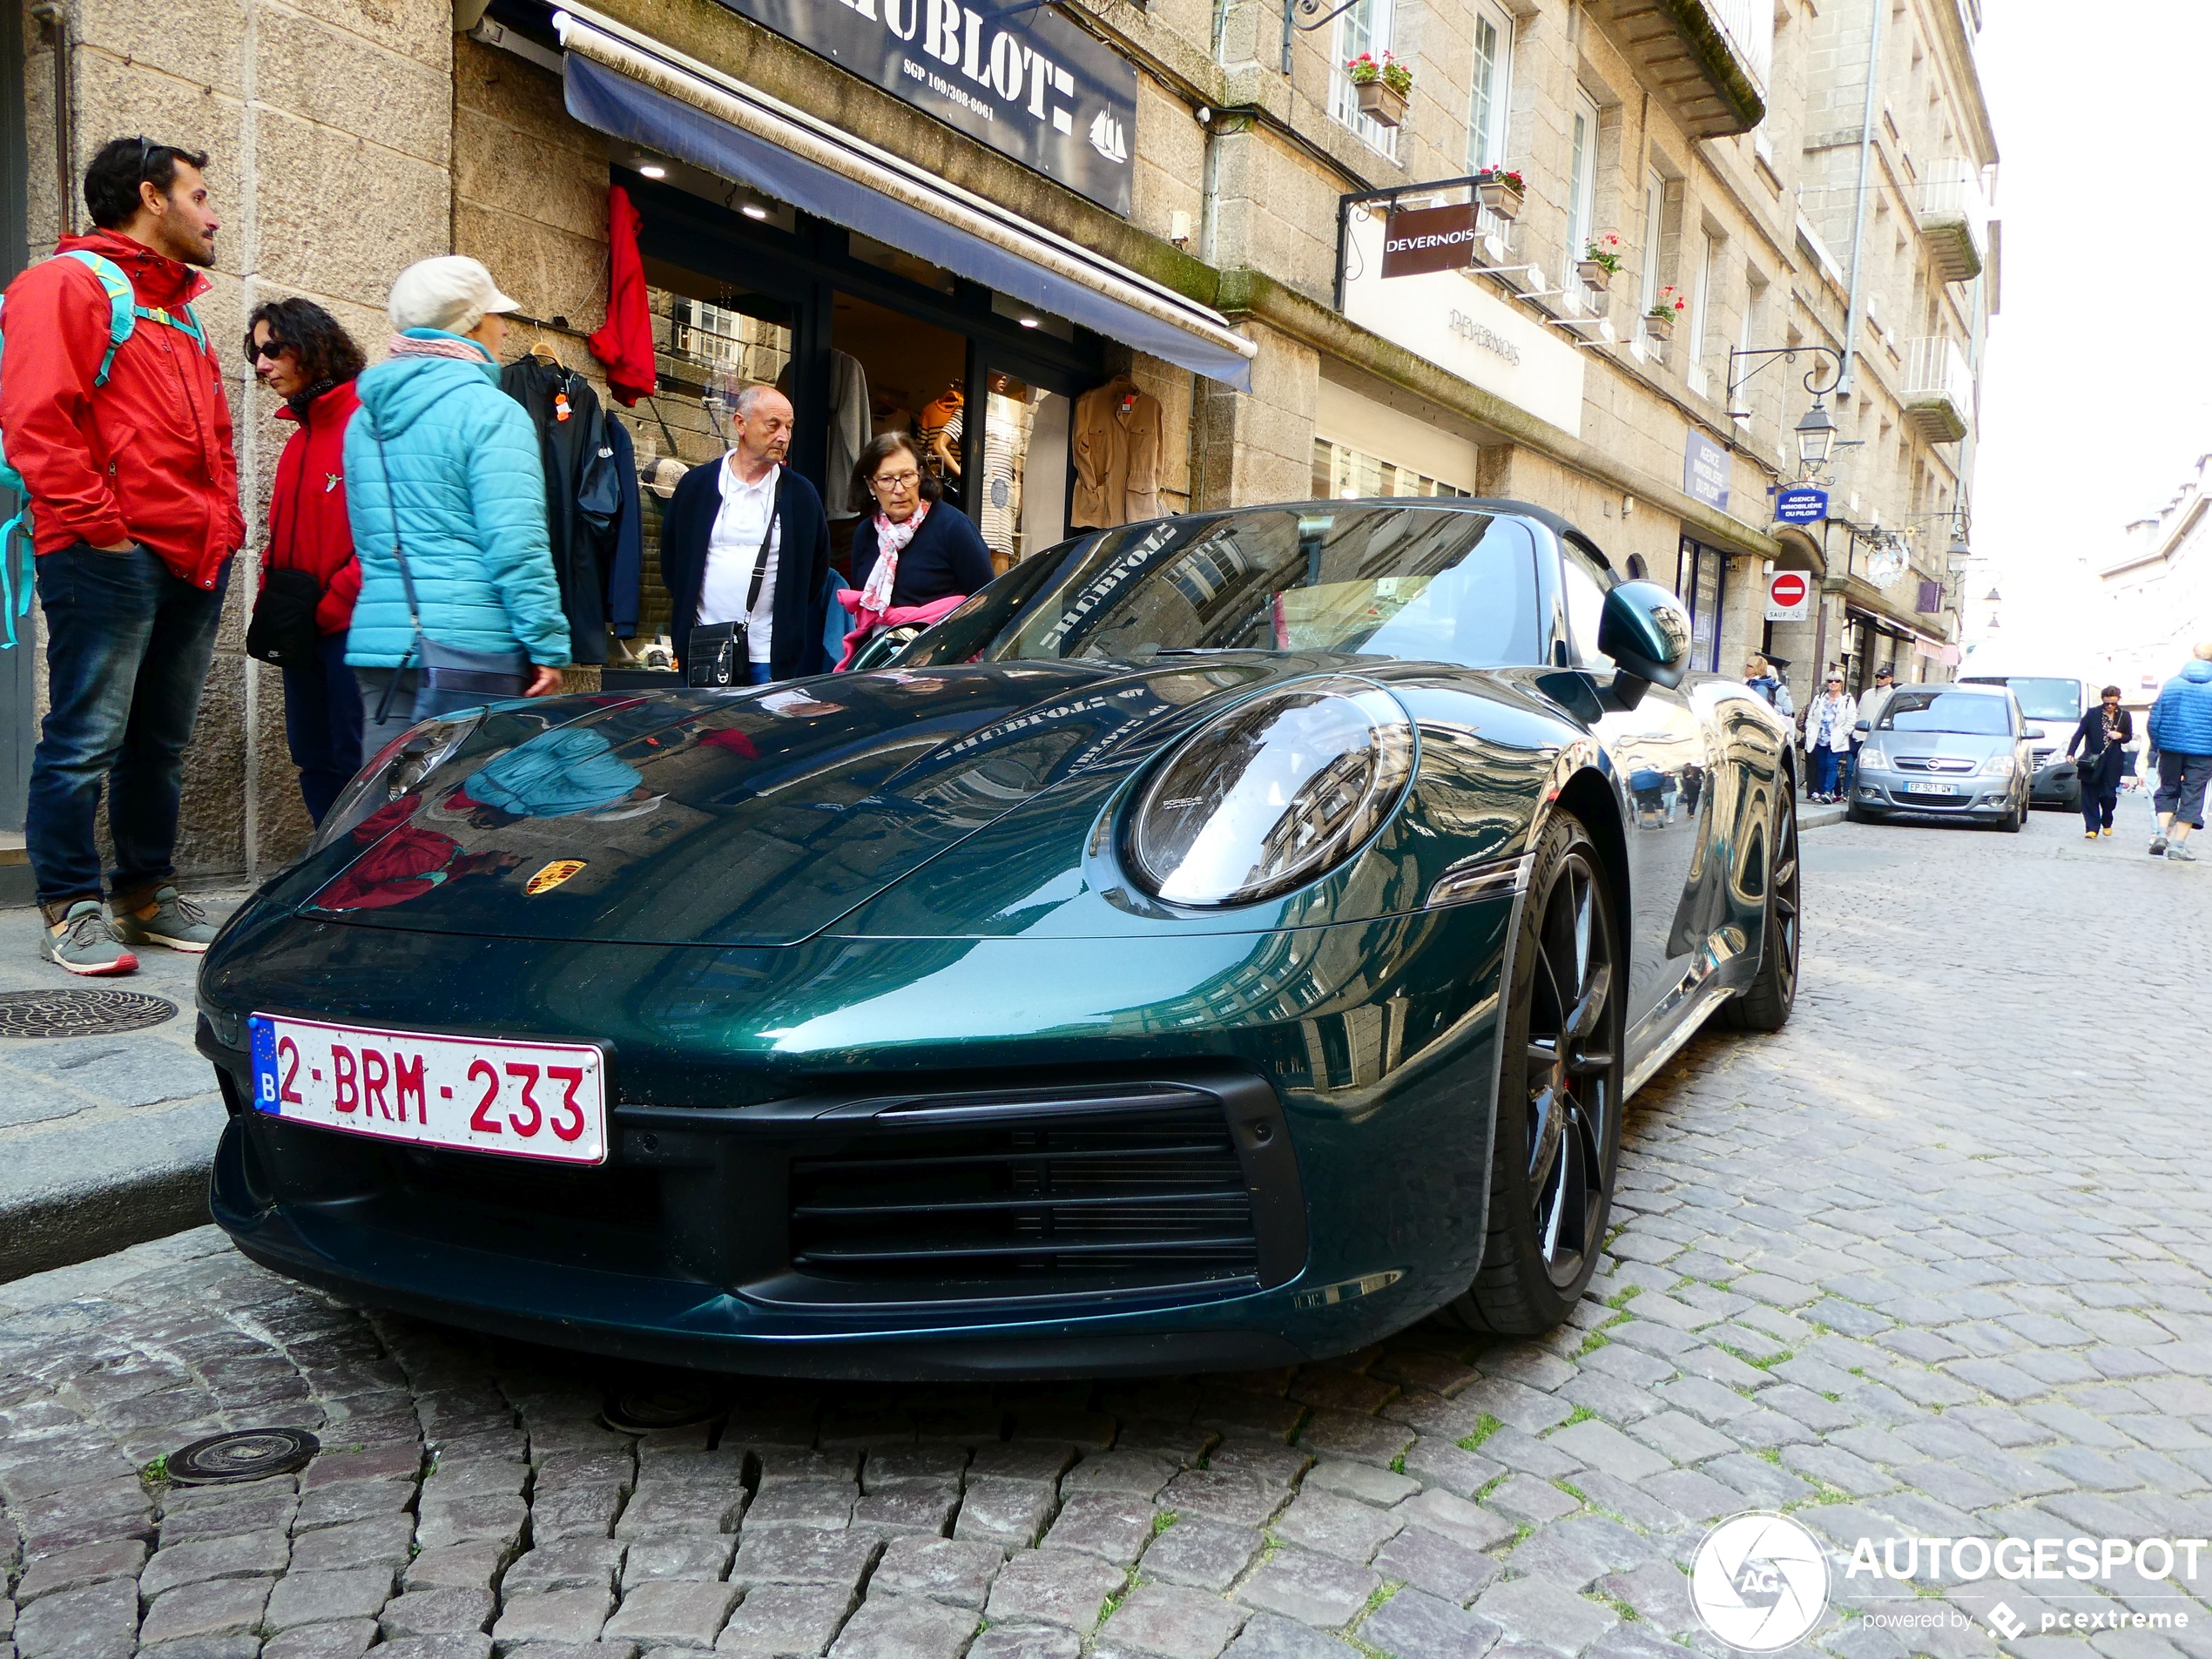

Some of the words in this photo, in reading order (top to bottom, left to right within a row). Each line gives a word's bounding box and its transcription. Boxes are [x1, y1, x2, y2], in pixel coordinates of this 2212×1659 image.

[838, 0, 1054, 120] UBLOT
[903, 58, 927, 83] SGP
[1386, 228, 1475, 253] DEVERNOIS
[1449, 308, 1521, 367] DEVERNOIS
[1700, 445, 1720, 469] AGENCE
[1696, 478, 1703, 494] DU
[1703, 482, 1719, 502] PILORI
[1910, 783, 1920, 792] EP
[1923, 784, 1938, 792] 921
[1163, 795, 1203, 806] PORSCHE
[1527, 911, 1536, 939] P
[1533, 839, 1560, 910] ZERO
[261, 1073, 275, 1103] B
[278, 1035, 586, 1142] 2-BRM-233
